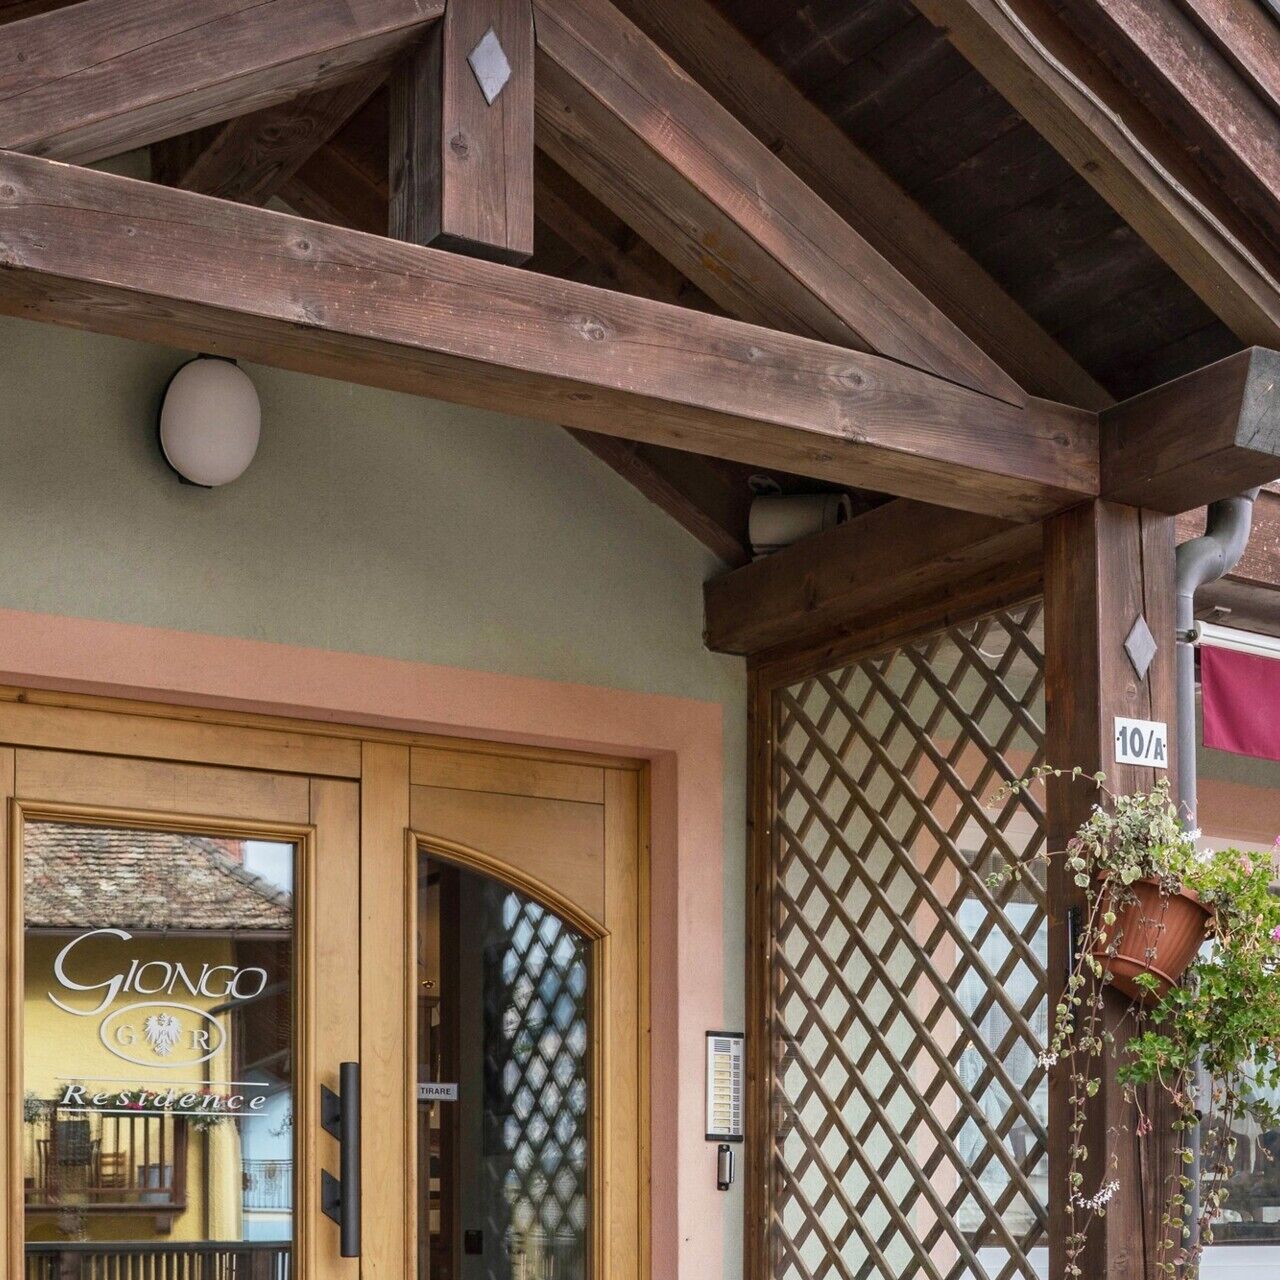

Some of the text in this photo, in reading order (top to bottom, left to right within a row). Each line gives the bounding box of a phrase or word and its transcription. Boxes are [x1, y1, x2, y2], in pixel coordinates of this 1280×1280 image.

[1119, 726, 1163, 761] 10/A
[47, 928, 269, 1016] GIONGO
[60, 1084, 267, 1110] Residence
[421, 1087, 452, 1096] TIRARE
